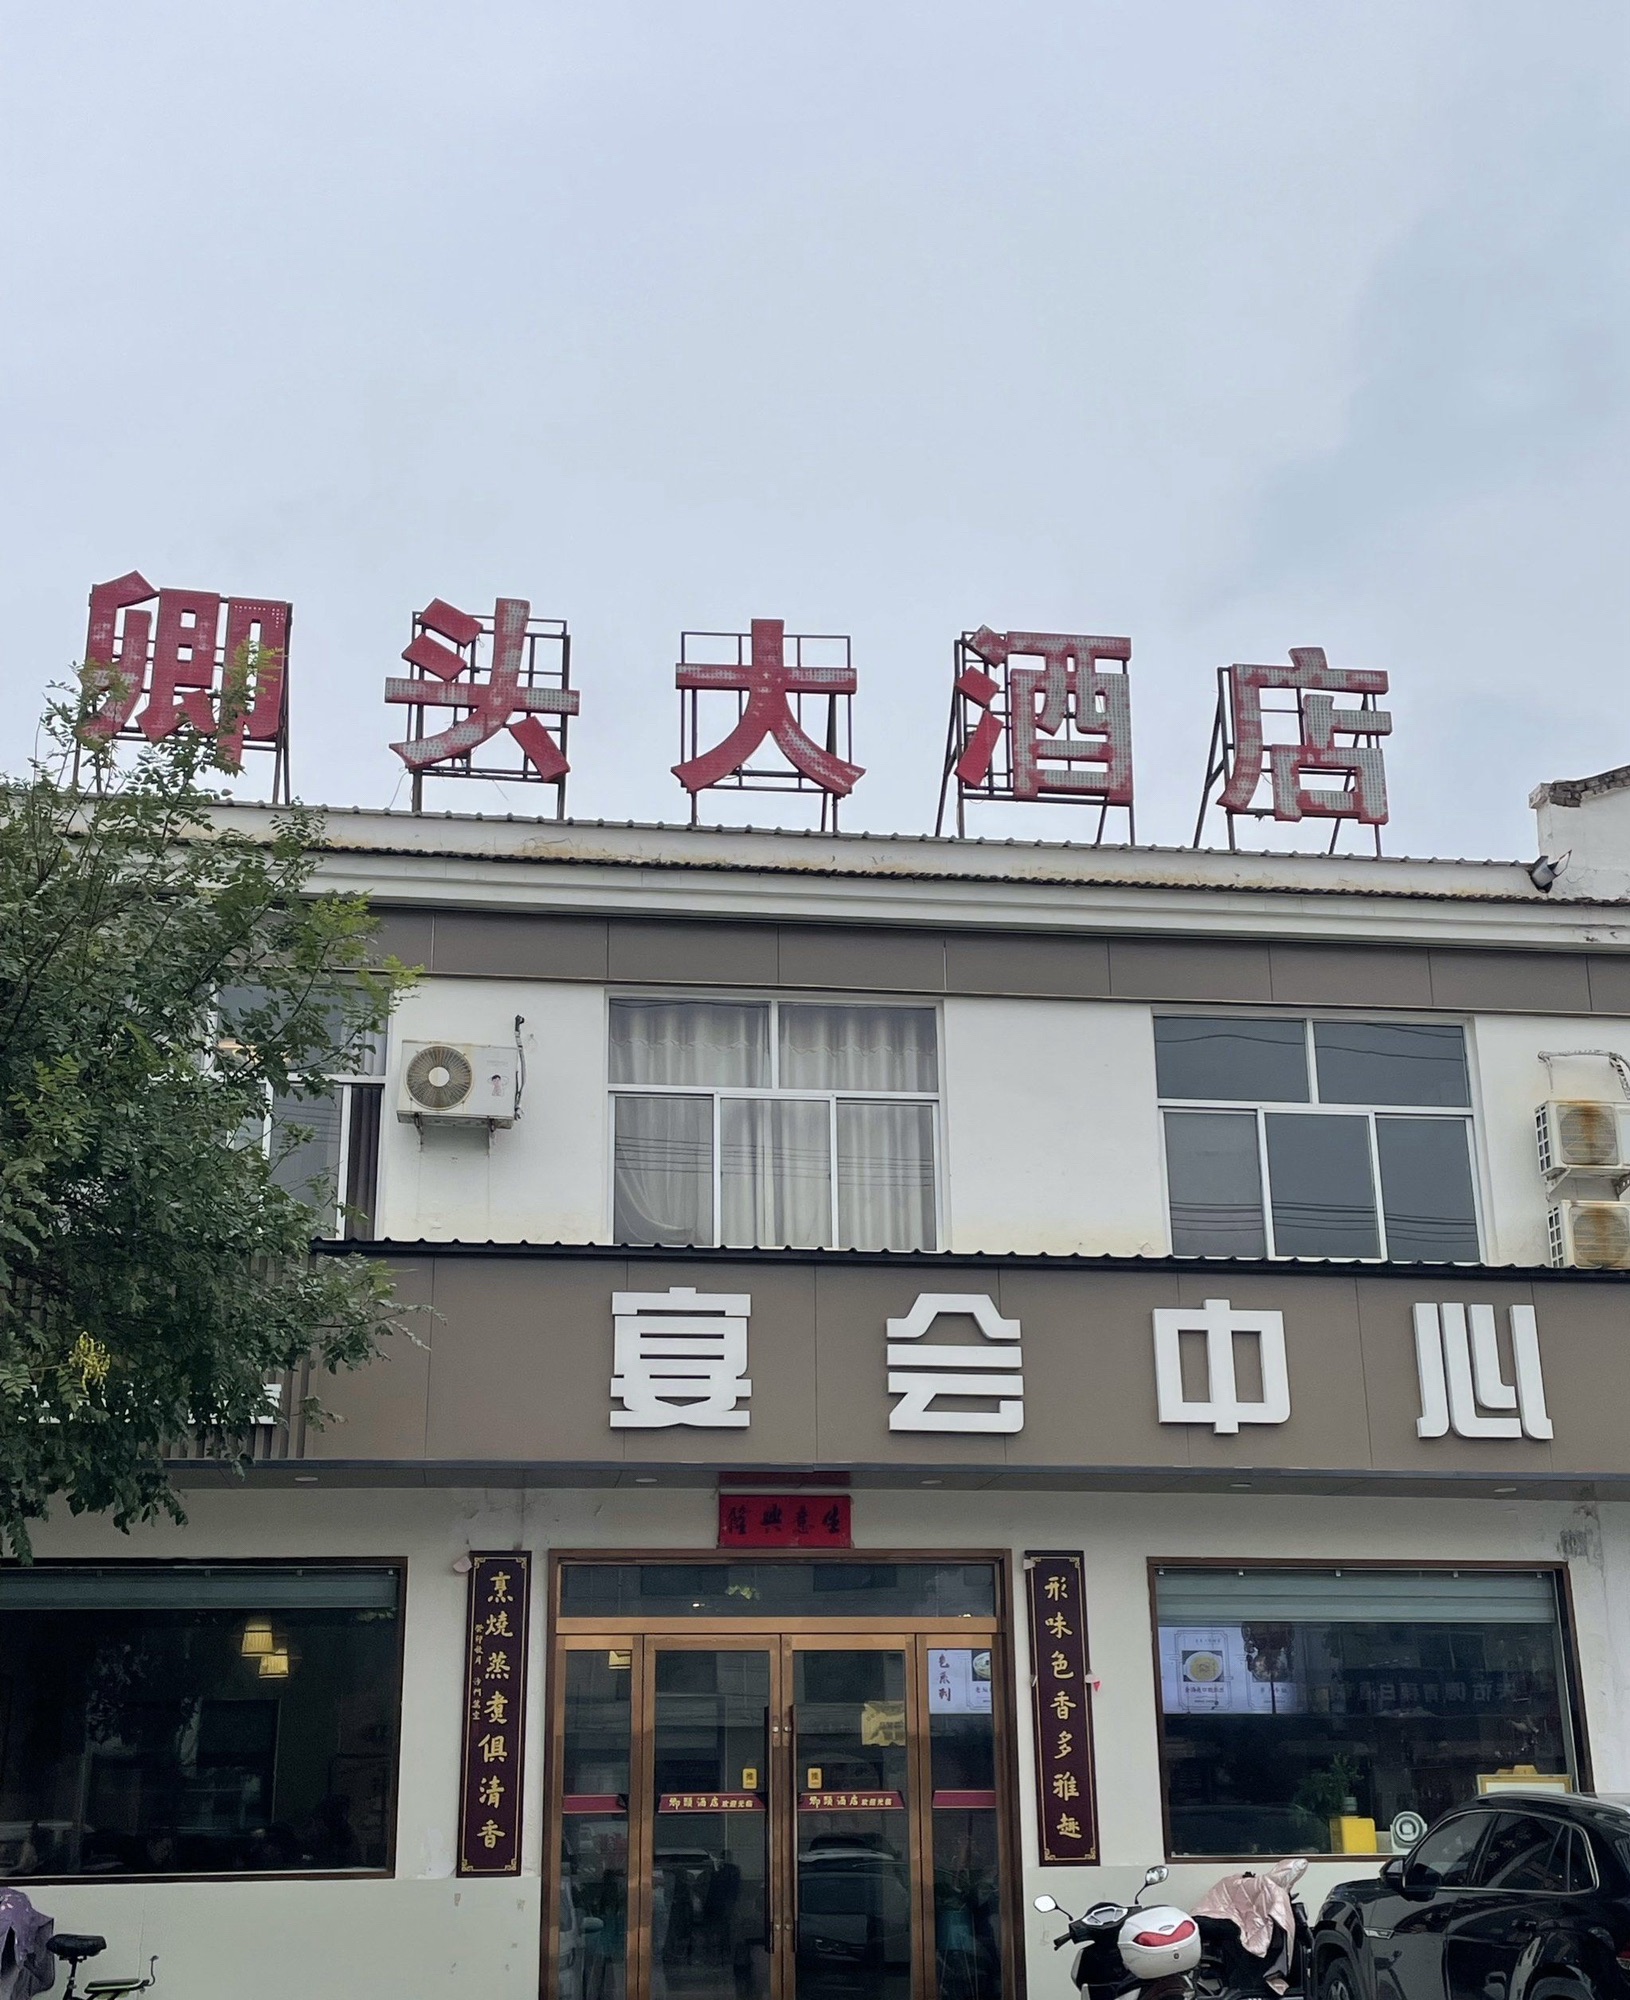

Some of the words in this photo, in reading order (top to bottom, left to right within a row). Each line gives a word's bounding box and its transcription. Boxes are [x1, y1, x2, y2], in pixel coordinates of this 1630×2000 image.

[78, 570, 1391, 824] 卿头大酒店
[610, 1286, 1553, 1440] 宴会中心
[1043, 1576, 1082, 1839] 形味色香多雅趣
